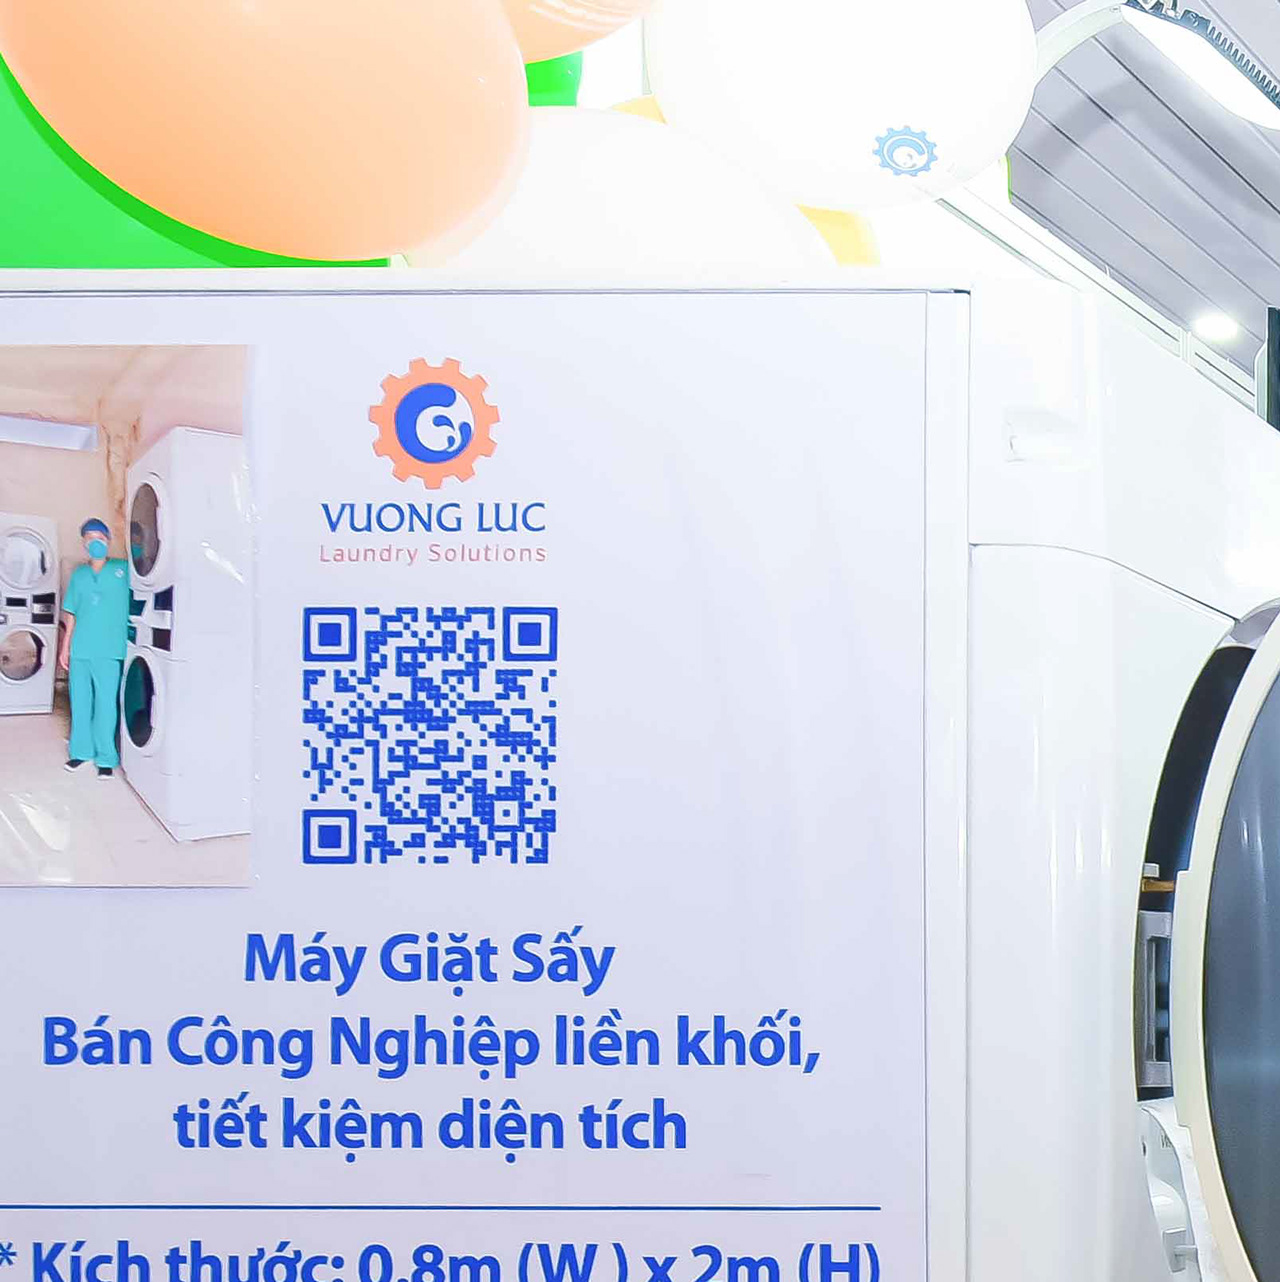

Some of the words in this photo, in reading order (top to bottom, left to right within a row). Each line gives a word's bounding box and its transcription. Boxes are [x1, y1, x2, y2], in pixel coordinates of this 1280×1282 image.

[320, 502, 462, 533] VUONG
[477, 502, 546, 533] LUC
[319, 541, 419, 568] Laundry
[427, 541, 547, 564] Solutions
[243, 930, 368, 997] Máy
[379, 931, 499, 998] Giặt
[511, 924, 616, 997] Sấy
[42, 1014, 154, 1068] Bán
[166, 1014, 315, 1080] Công
[330, 1014, 541, 1080] Nghiệp
[553, 1008, 661, 1068] liền
[676, 1008, 821, 1076] khối,
[172, 1091, 268, 1151] tiết
[281, 1096, 424, 1164] kiệm
[437, 1096, 565, 1164] diện
[580, 1096, 688, 1151] tích
